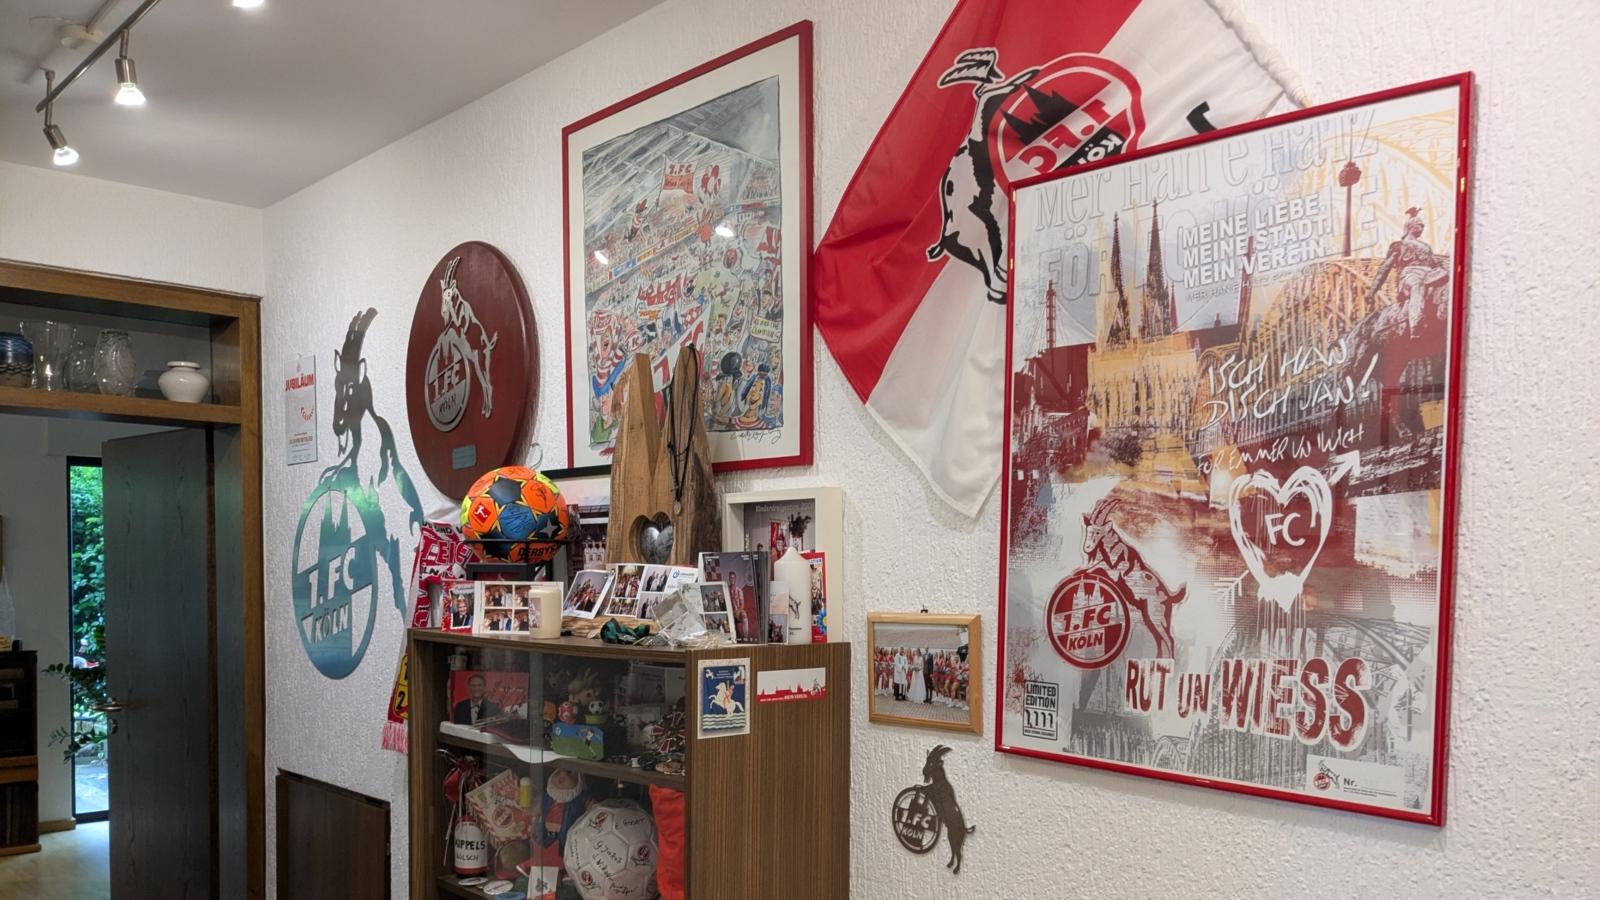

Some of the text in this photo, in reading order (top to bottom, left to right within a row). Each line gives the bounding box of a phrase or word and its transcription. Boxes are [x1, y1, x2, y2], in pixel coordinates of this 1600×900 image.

[1183, 212, 1249, 248] MEINE
[1183, 234, 1250, 269] MEINE
[1184, 258, 1237, 290] MEIN
[1208, 353, 1268, 395] ISCH
[1200, 383, 1291, 431] DISCH
[1264, 512, 1306, 547] FC
[308, 547, 356, 610] 1.FC
[1063, 605, 1112, 633] 1.FC
[1068, 631, 1104, 651] KÖLN
[1025, 694, 1056, 709] EDITION
[1026, 683, 1057, 697] LIMITED
[1126, 656, 1372, 748] RUT UN WIESS
[1343, 777, 1358, 787] Nr.
[901, 809, 932, 829] 1.FC
